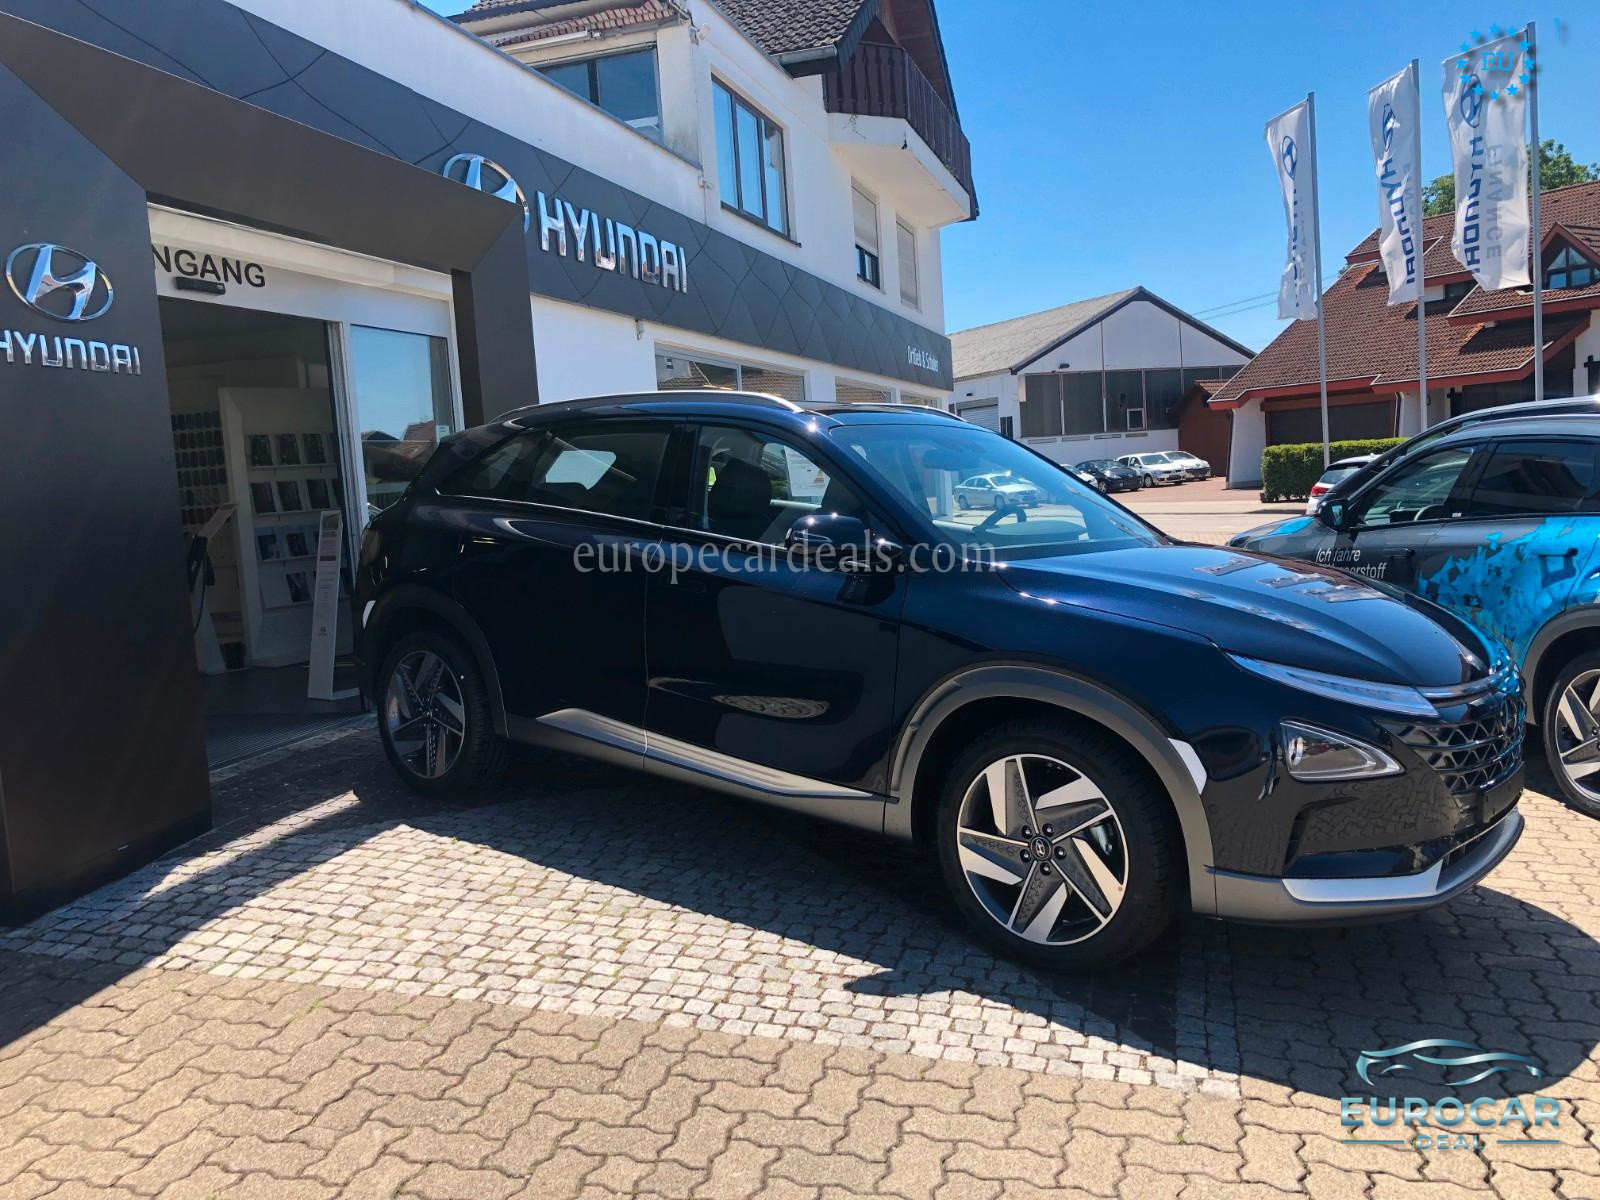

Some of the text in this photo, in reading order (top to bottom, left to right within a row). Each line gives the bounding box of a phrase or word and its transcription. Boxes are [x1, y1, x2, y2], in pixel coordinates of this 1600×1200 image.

[537, 190, 687, 294] HYUNDAI
[1315, 547, 1361, 562] Ich fahre
